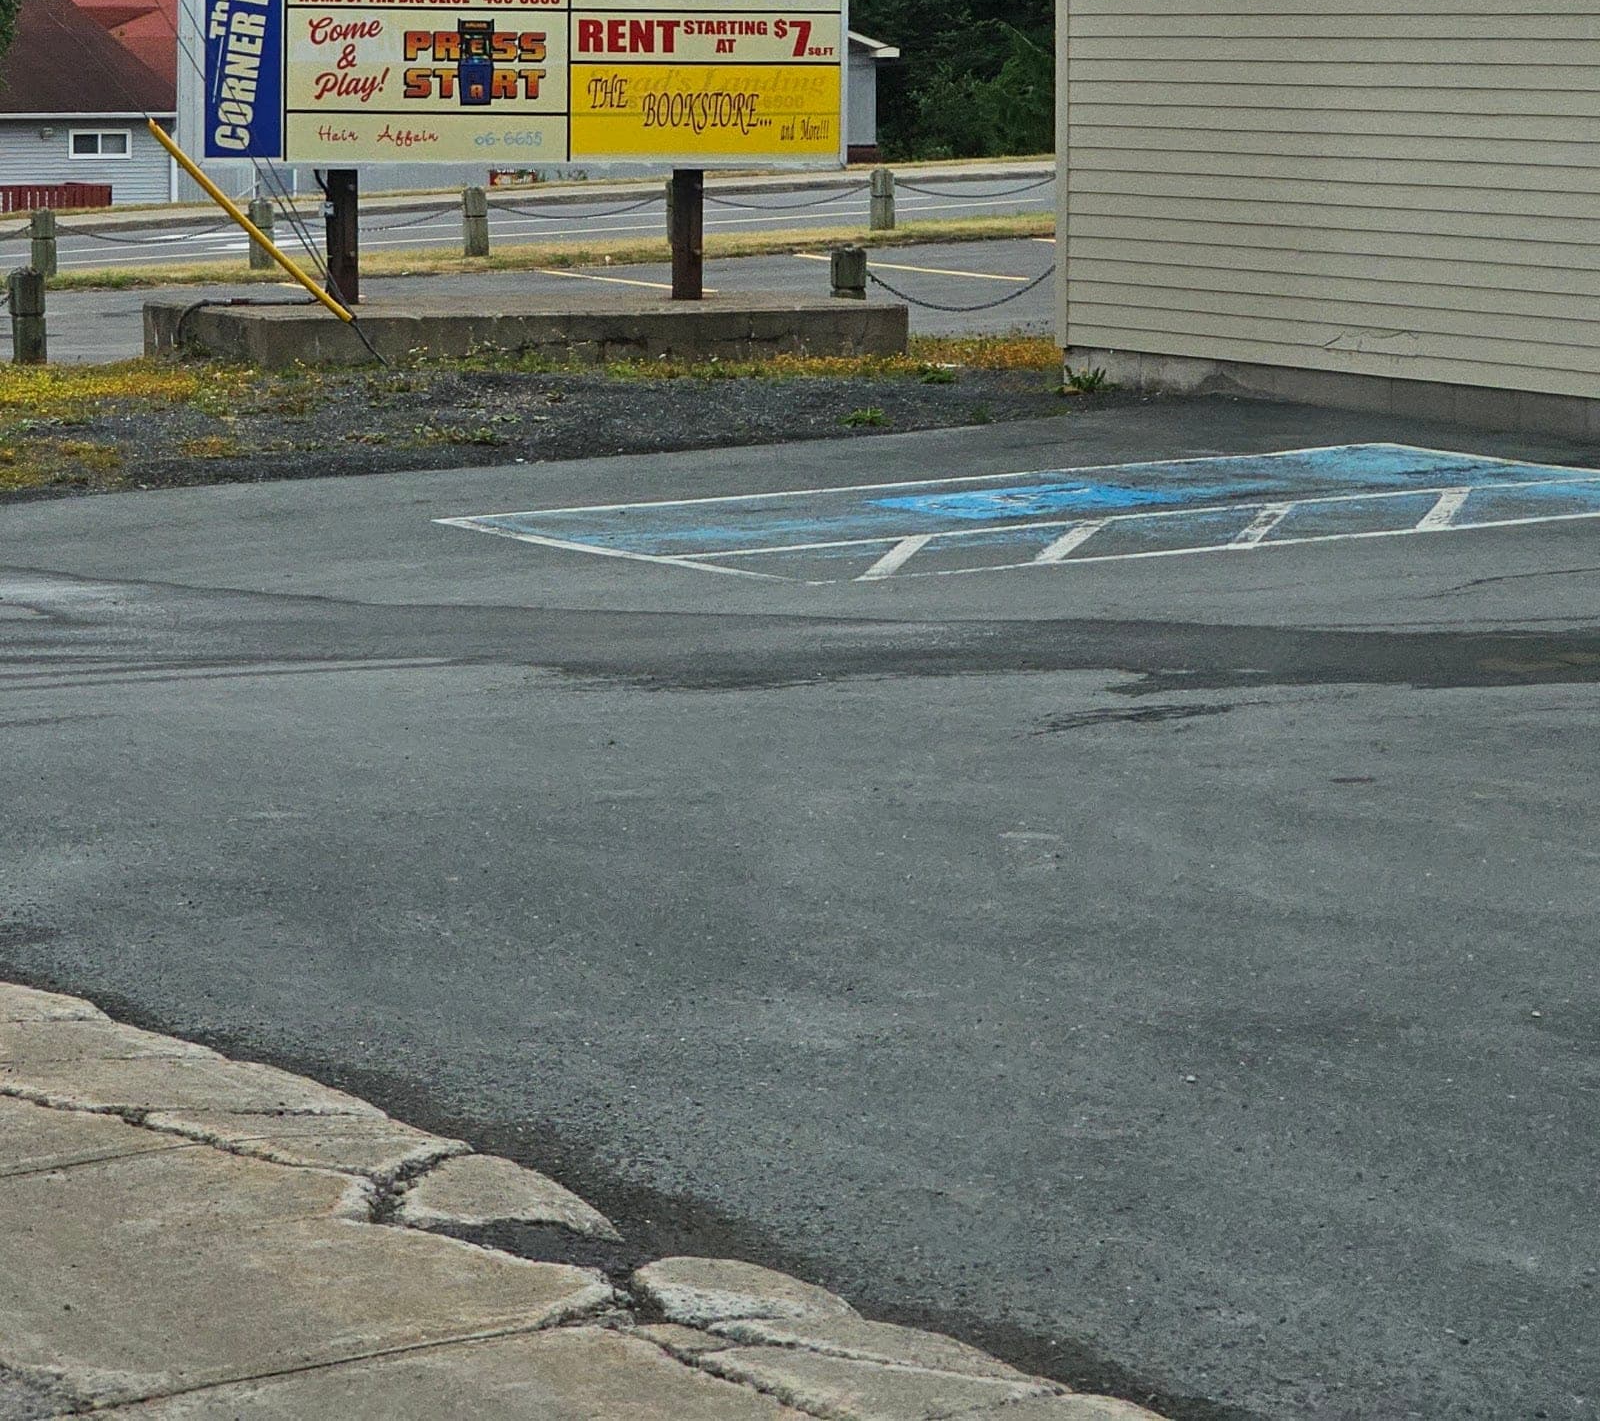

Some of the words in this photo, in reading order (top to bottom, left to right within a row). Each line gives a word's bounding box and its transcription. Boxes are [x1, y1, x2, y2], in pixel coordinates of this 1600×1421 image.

[308, 17, 383, 45] Come
[403, 30, 546, 62] PRESS
[578, 19, 681, 54] RENT
[683, 20, 768, 36] STARTING
[337, 45, 357, 70] &
[715, 39, 736, 54] AT
[215, 10, 266, 151] CORNER
[314, 67, 390, 102] Play!
[587, 74, 629, 109] THE
[318, 125, 359, 143] Hair
[376, 123, 439, 147] Affair
[780, 115, 795, 141] and
